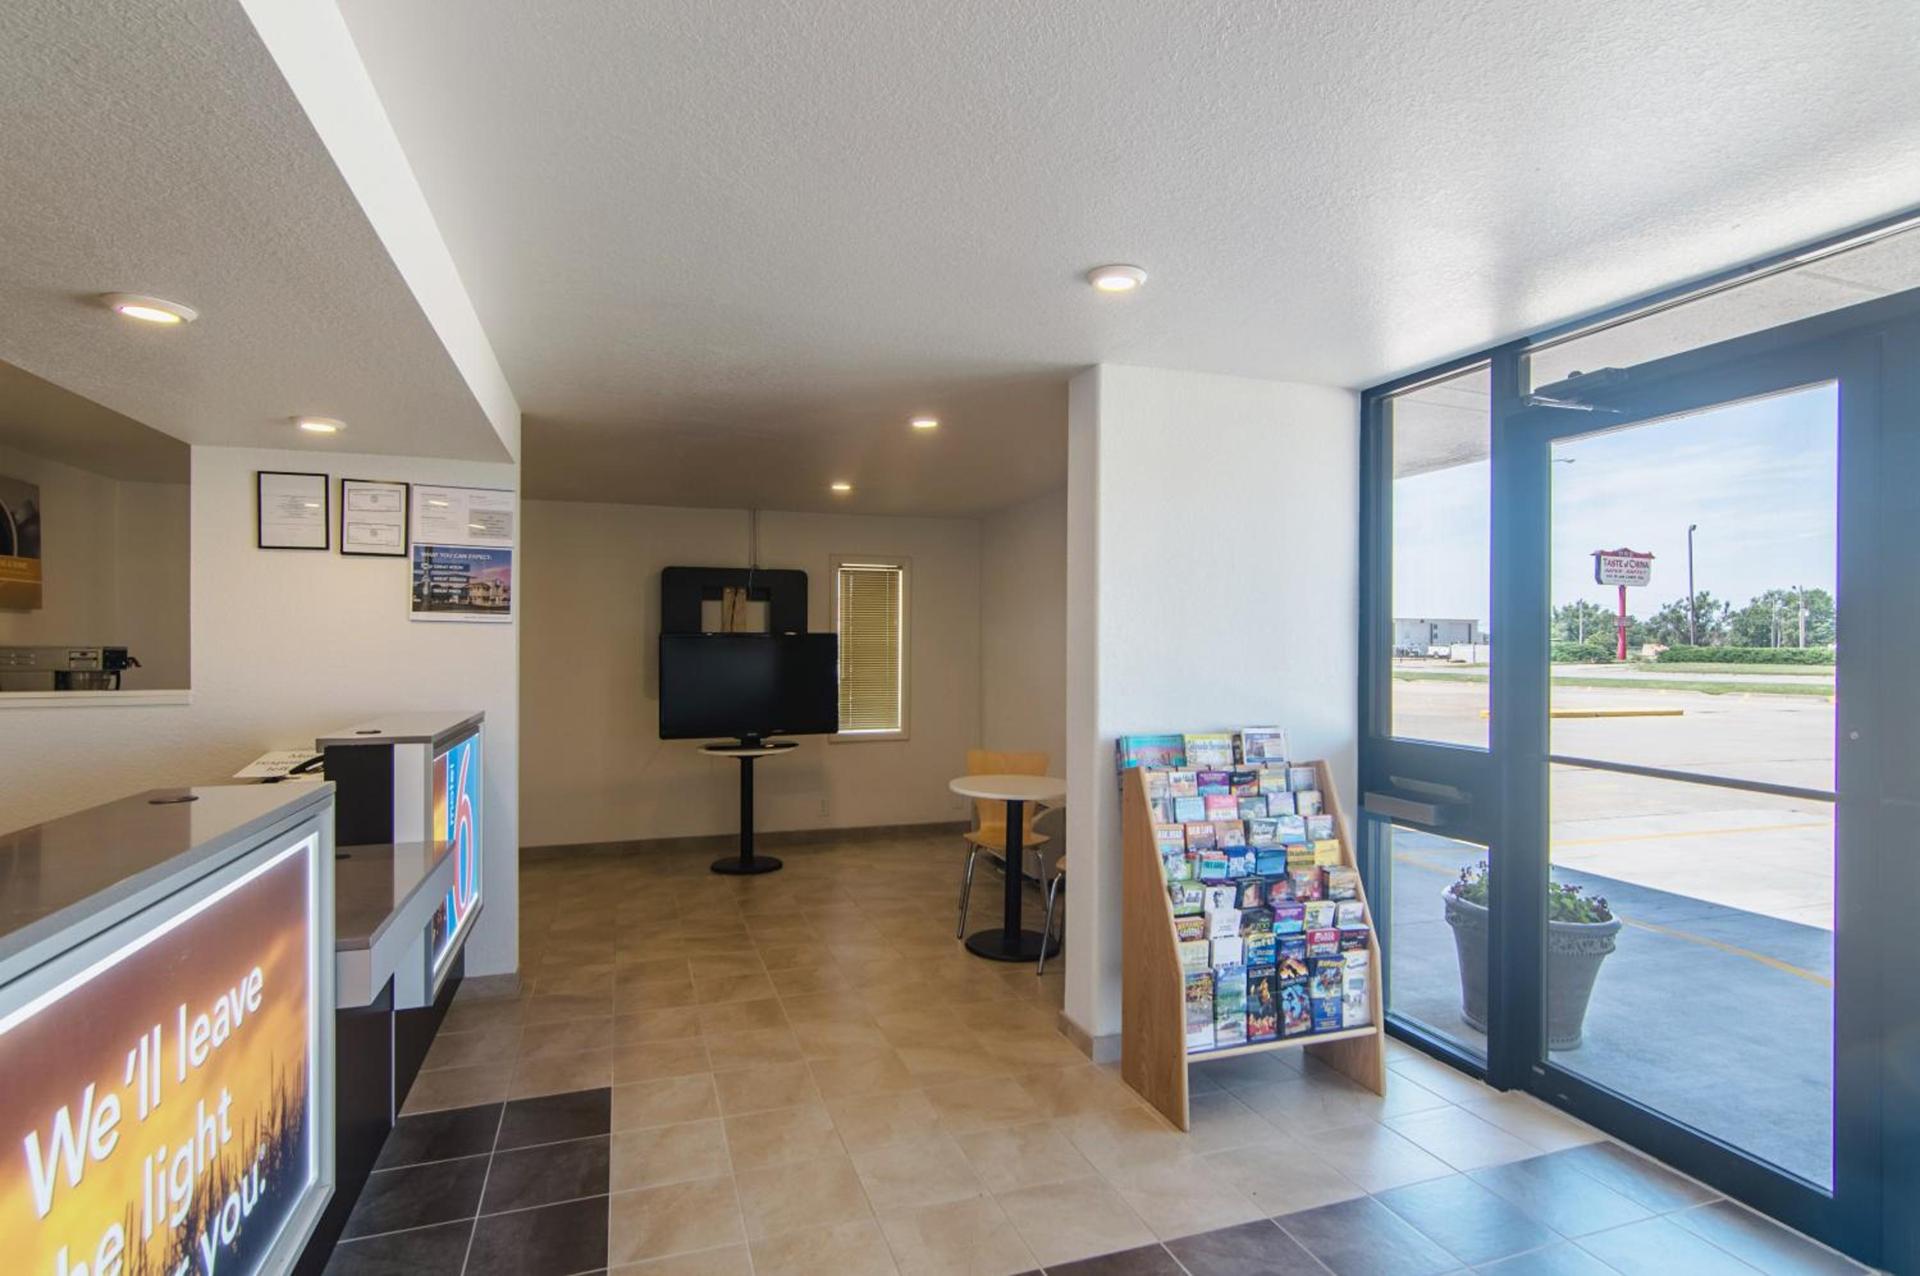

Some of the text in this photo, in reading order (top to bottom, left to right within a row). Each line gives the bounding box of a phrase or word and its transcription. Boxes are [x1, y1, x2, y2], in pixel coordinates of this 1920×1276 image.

[1603, 558, 1623, 568] TASTE
[452, 743, 473, 923] 6
[23, 965, 264, 1221] We'll leave
[142, 1087, 233, 1241] light
